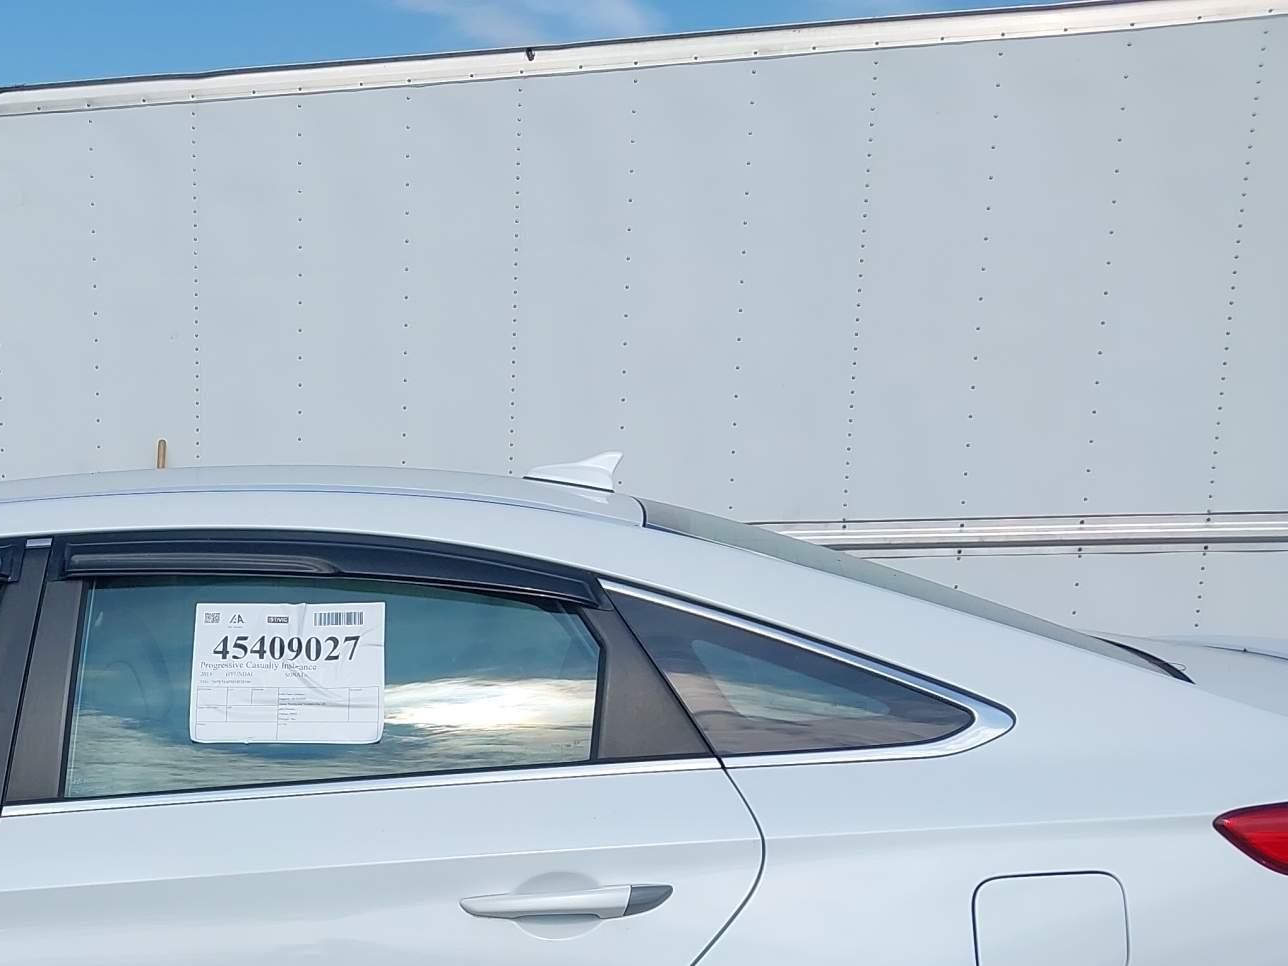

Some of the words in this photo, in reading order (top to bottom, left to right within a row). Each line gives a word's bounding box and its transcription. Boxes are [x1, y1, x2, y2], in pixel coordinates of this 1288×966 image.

[213, 635, 360, 661] 45409027
[200, 661, 243, 670] Progressive
[246, 661, 278, 670] Casualty
